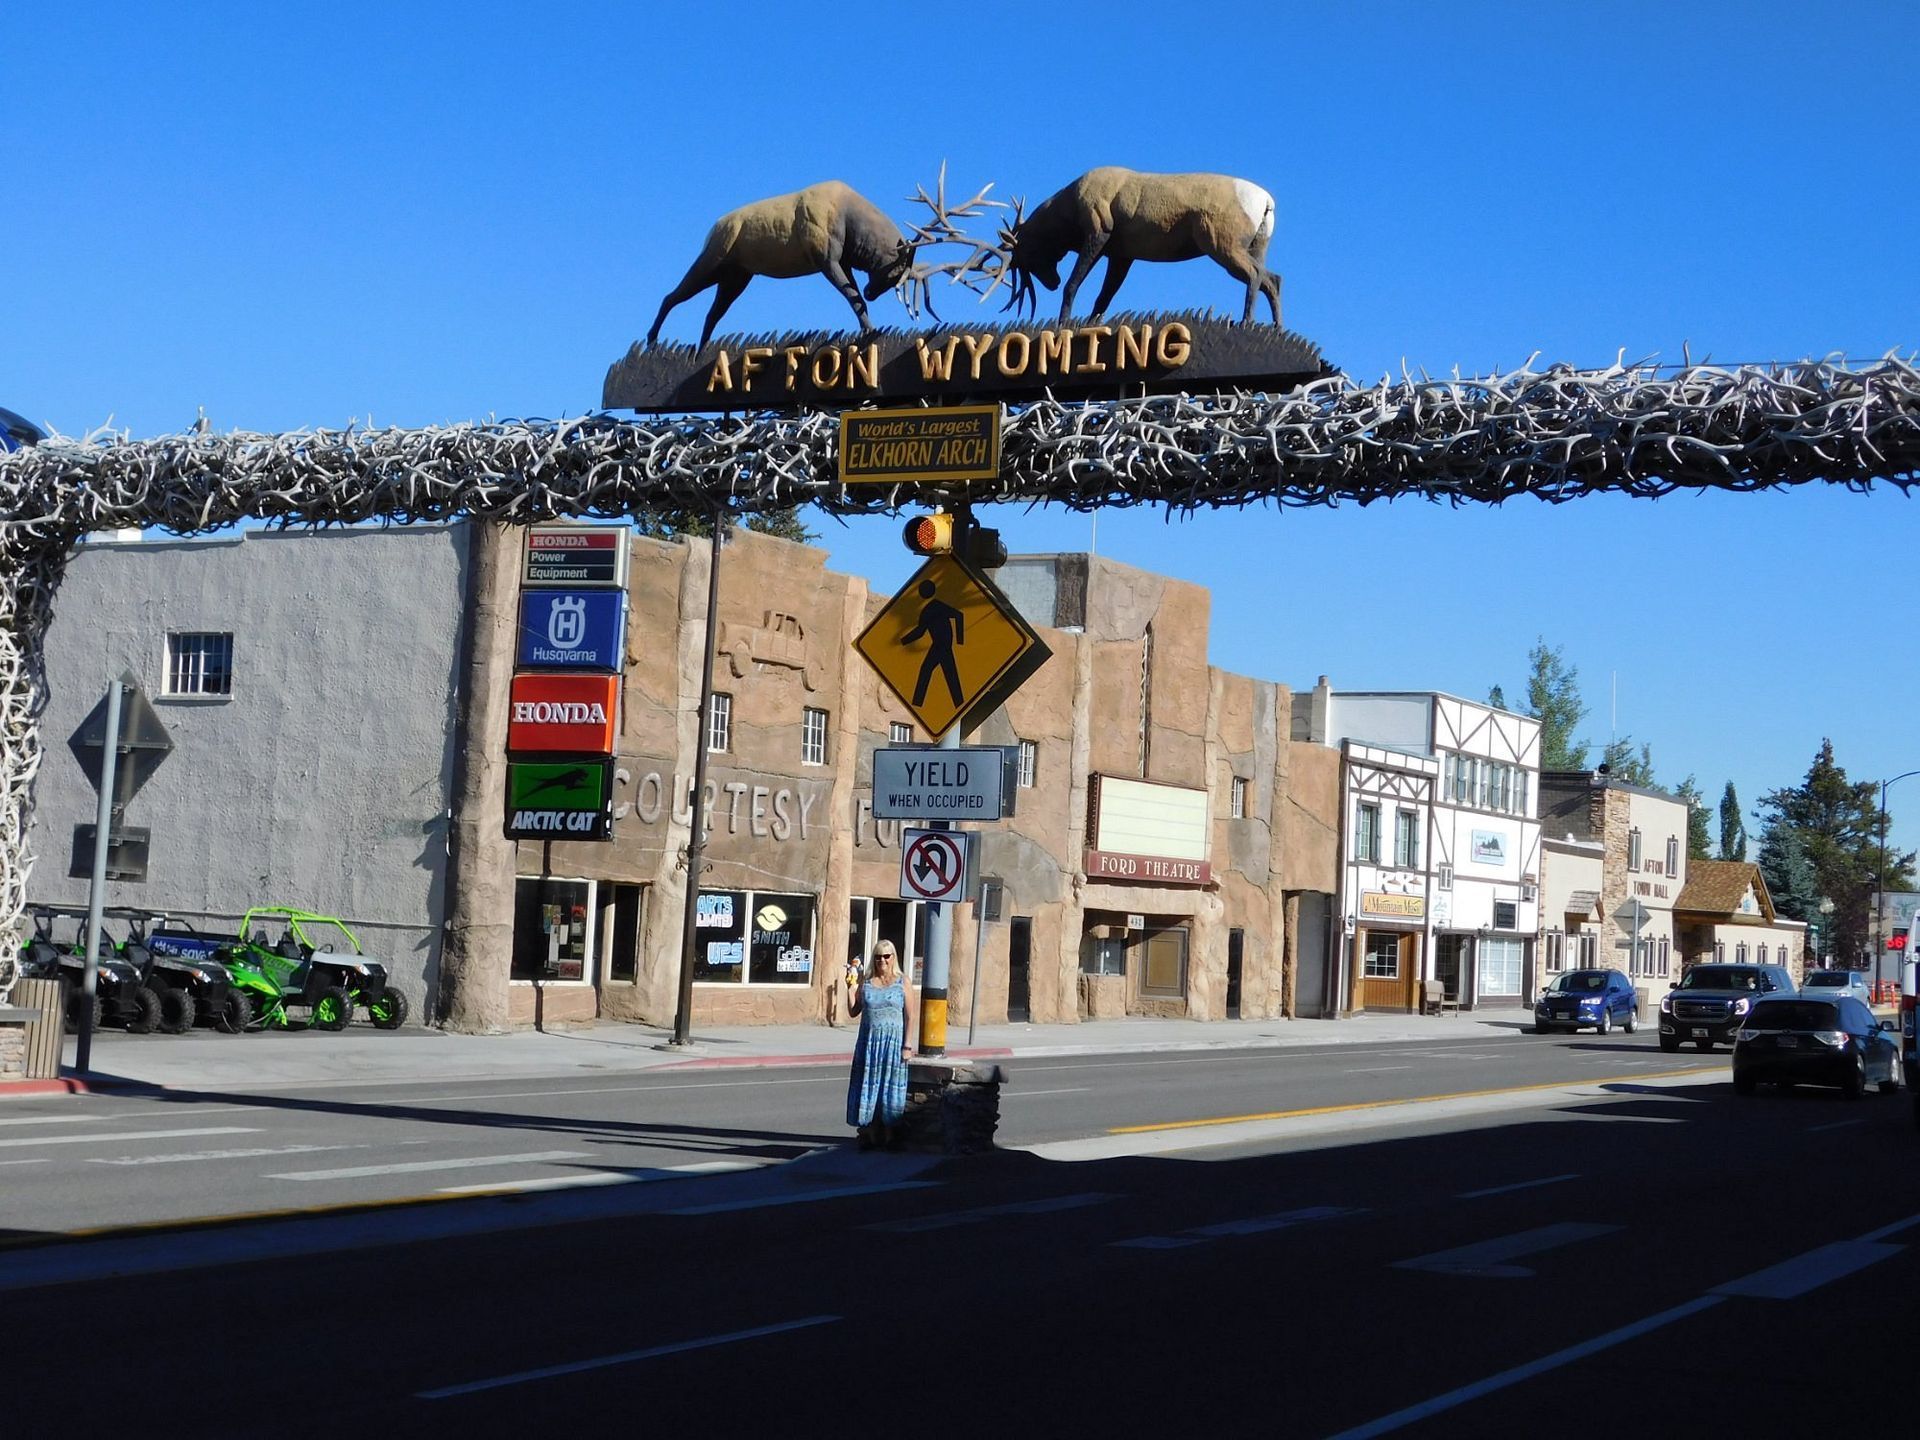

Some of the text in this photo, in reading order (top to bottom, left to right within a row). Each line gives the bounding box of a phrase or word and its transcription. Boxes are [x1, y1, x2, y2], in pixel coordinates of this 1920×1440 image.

[707, 321, 1191, 392] AFTON WYOMING
[858, 418, 981, 438] World's Largest
[849, 439, 987, 469] ELKHORN ARCH
[532, 536, 588, 547] HONDA
[531, 551, 566, 562] Power
[530, 568, 588, 579] Equipment
[533, 647, 597, 663] Husqvarna
[512, 702, 607, 724] HONDA
[905, 761, 969, 787] YIELD
[614, 768, 816, 841] COURTESY
[889, 794, 984, 809] WHEN OCCUPIED
[511, 811, 597, 831] ARCTIC CAT
[1100, 856, 1200, 881] FORD THEATRE
[1643, 858, 1664, 875] AFTON
[697, 895, 733, 915] ARTS
[752, 931, 790, 945] SMITH
[777, 945, 812, 962] GoPro
